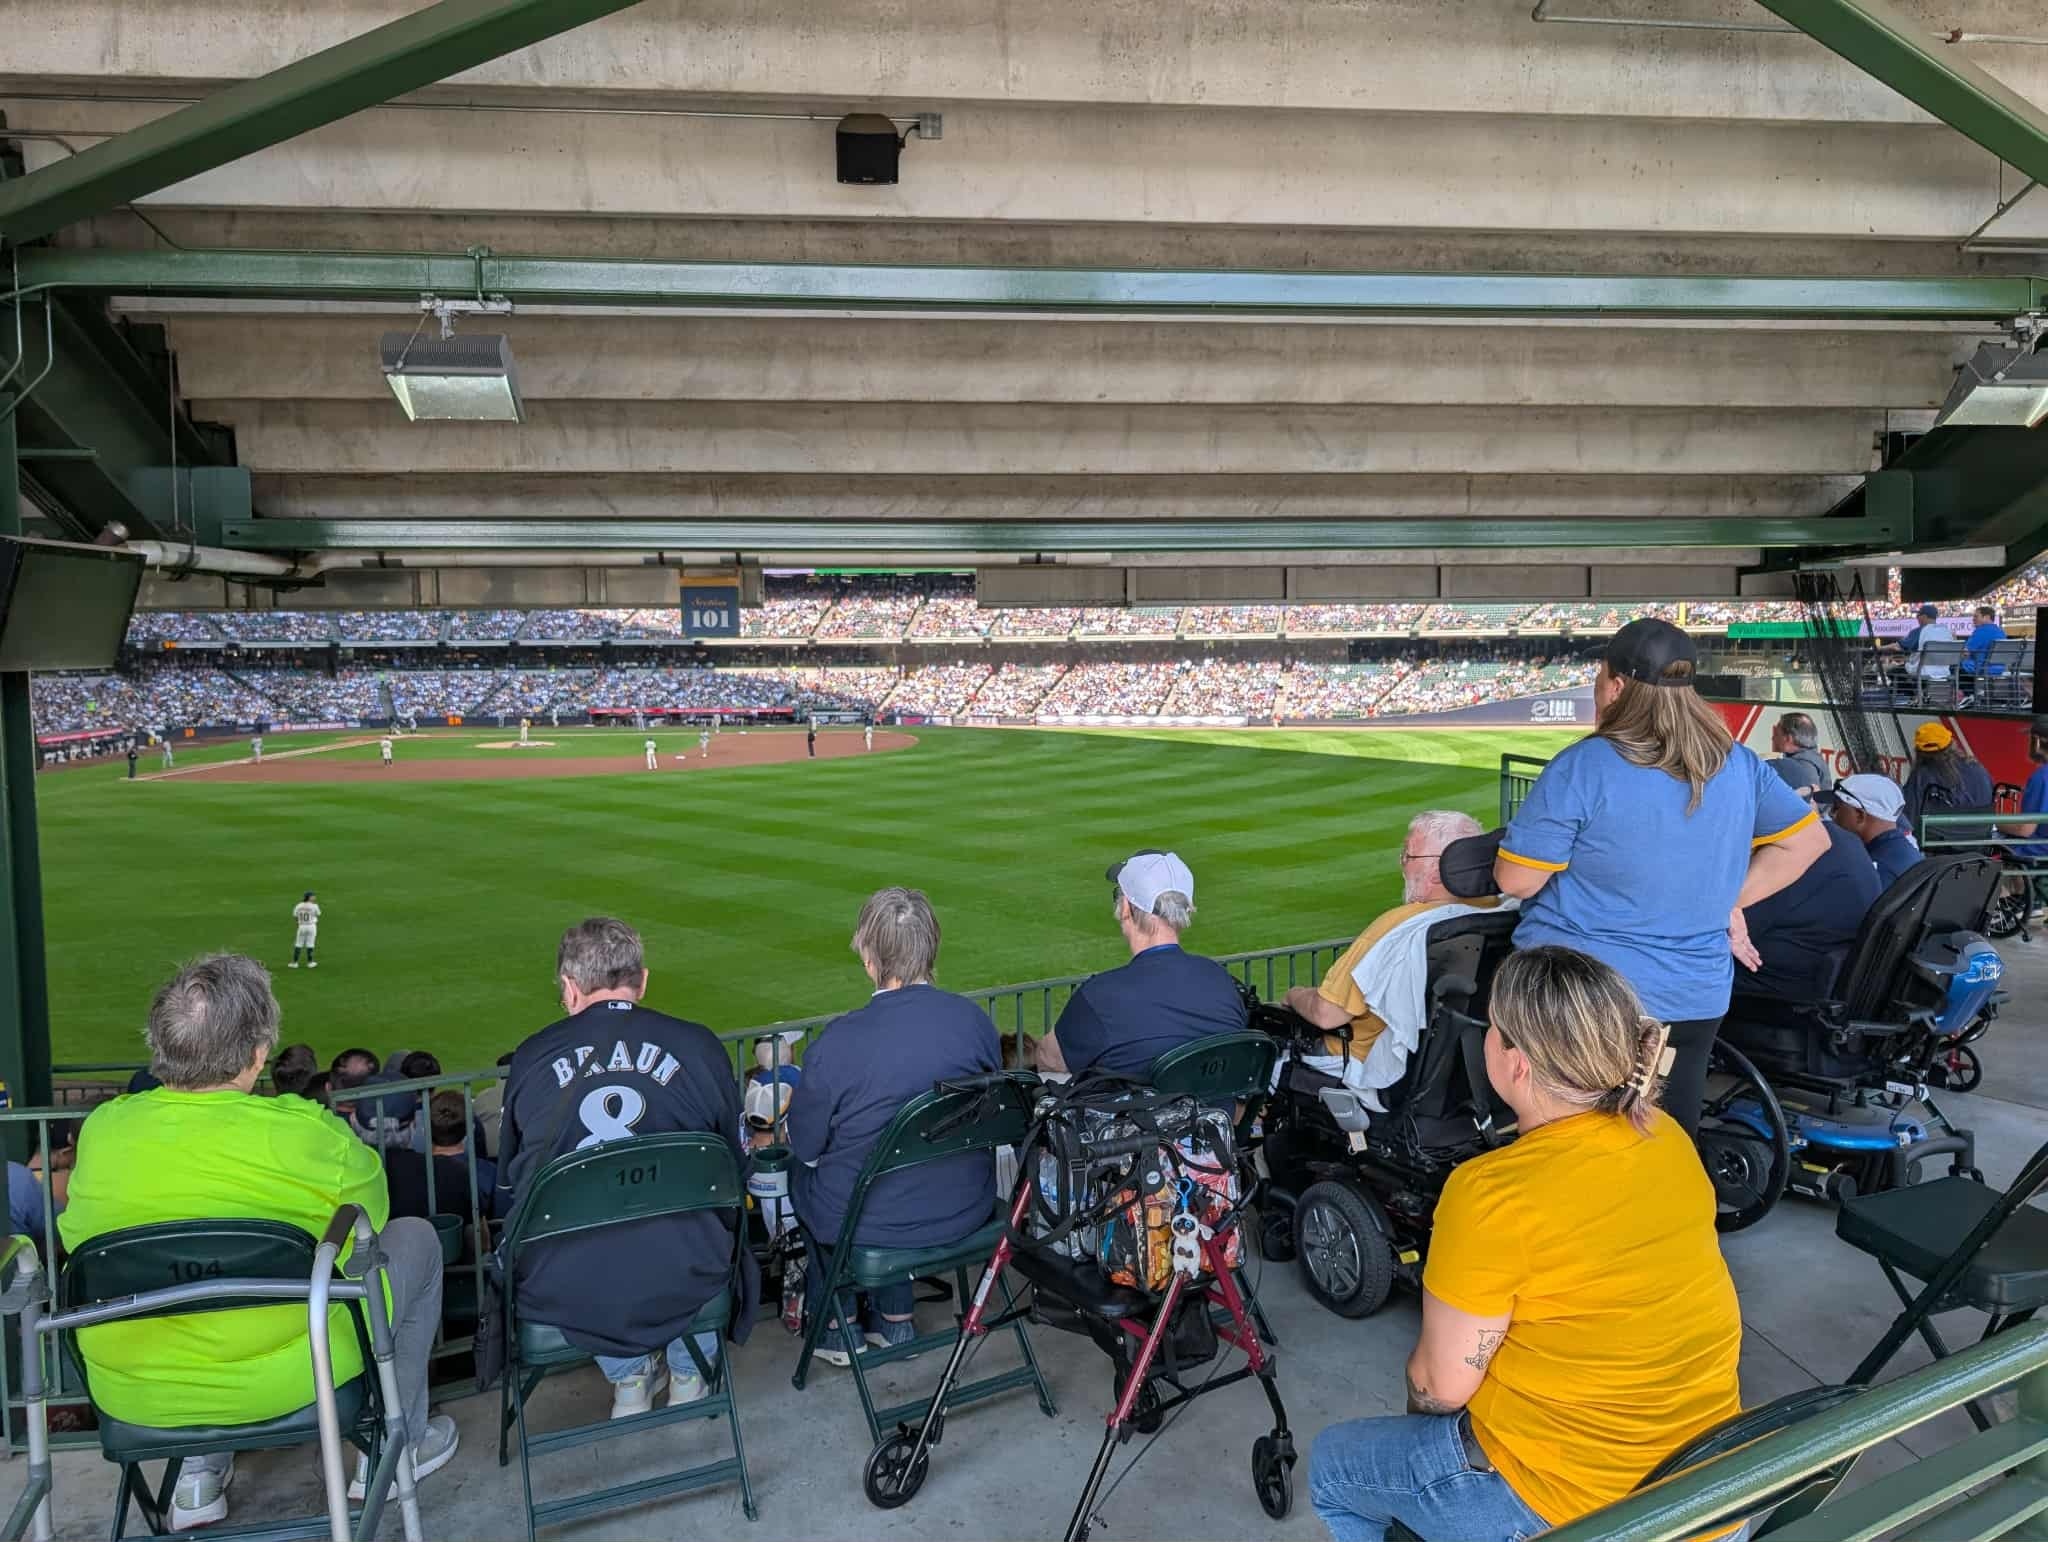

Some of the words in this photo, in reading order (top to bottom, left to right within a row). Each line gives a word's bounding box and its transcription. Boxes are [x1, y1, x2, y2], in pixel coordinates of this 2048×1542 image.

[692, 610, 729, 628] 101
[1820, 748, 1913, 786] TOOT
[552, 1040, 681, 1088] BRAUN
[576, 1086, 647, 1150] 8
[616, 1165, 657, 1186] 101
[168, 1260, 224, 1281] 104
